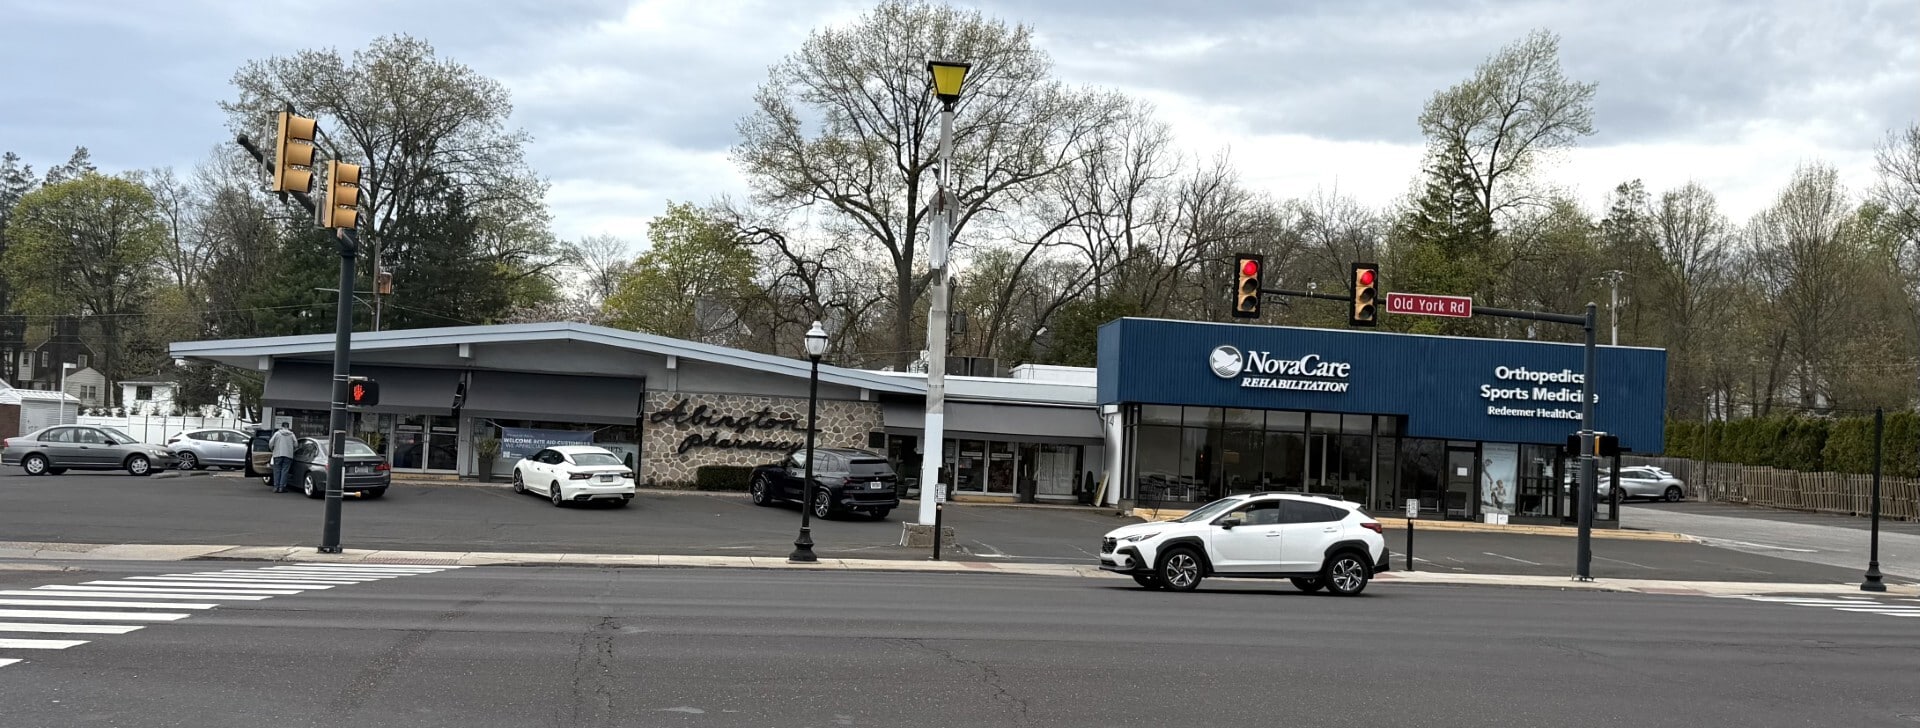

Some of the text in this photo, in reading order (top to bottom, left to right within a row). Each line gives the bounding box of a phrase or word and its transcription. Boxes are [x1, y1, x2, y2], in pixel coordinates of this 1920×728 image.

[1393, 297, 1465, 313] Old York Rd
[1243, 350, 1351, 377] NovaCare
[1240, 377, 1349, 392] REHABILITATION
[1494, 365, 1585, 385] Orthopedics
[1480, 384, 1599, 404] Sports Medicie
[650, 398, 823, 434] Abington
[1487, 405, 1536, 418] Redeemer
